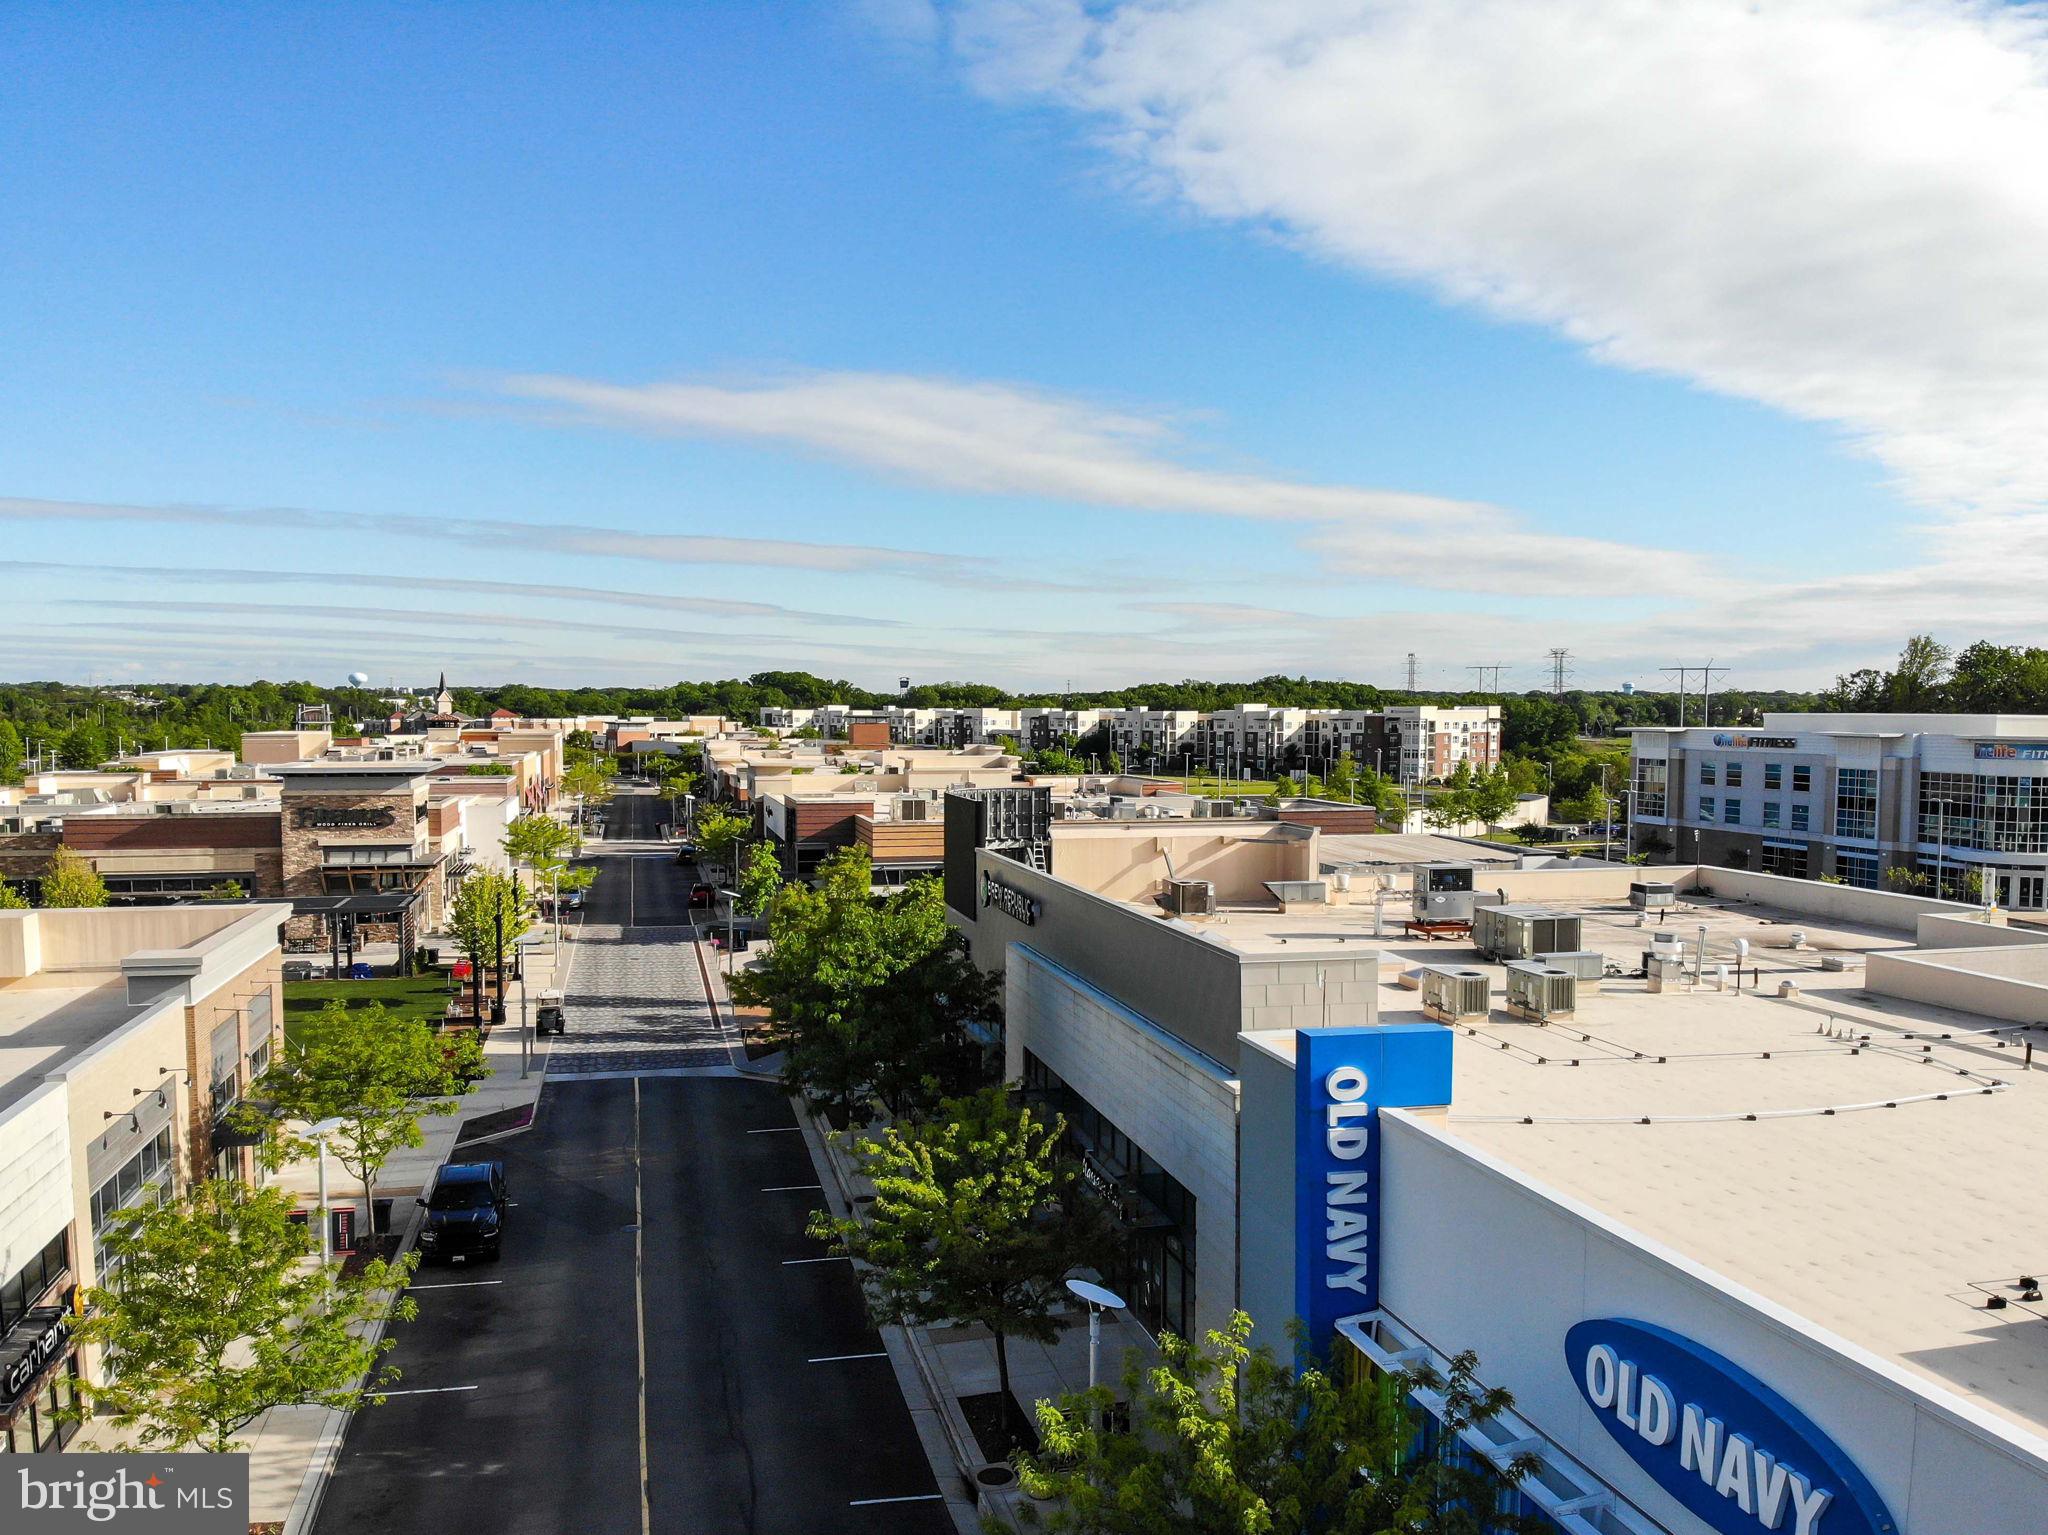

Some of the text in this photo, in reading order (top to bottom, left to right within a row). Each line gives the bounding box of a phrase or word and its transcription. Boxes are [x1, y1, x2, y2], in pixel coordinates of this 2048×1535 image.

[1749, 737, 1797, 748] FITNESS
[1004, 887, 1031, 913] REPUBLIC
[1325, 1066, 1368, 1296] OLD NAVY
[1586, 1343, 1834, 1535] OLD NAVY
